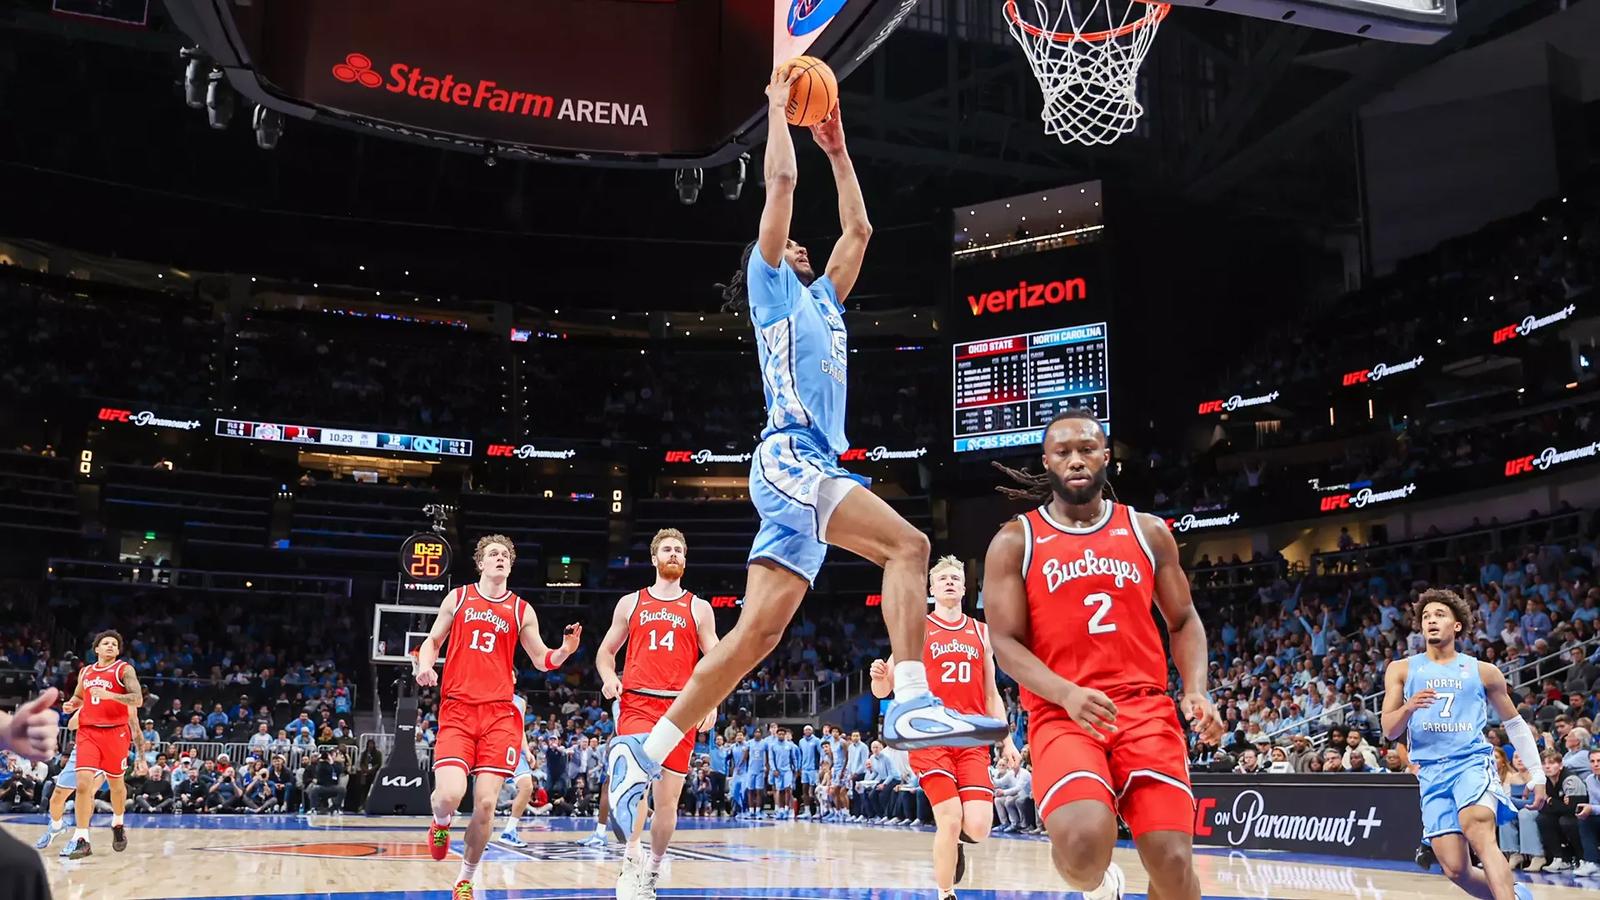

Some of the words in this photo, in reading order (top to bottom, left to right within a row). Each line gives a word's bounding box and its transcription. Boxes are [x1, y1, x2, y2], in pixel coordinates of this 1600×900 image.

[557, 98, 648, 127] ARENA
[968, 277, 1086, 316] verizon
[1033, 334, 1060, 346] NORTH
[1061, 327, 1102, 340] CAROLINA
[1493, 324, 1518, 344] UFC
[968, 344, 988, 354] OHIO
[990, 340, 1014, 352] STATE
[1343, 370, 1370, 386] UFC
[98, 408, 131, 422] UFC
[1199, 400, 1224, 414] UFC
[298, 427, 308, 438] 11
[330, 433, 353, 443] 10:23
[977, 436, 999, 448] CBS
[1000, 430, 1042, 446] SPORTS
[487, 445, 516, 456] UFC
[666, 451, 693, 462] UFC
[1505, 454, 1535, 476] UFC
[1320, 494, 1352, 511] UFC
[415, 543, 442, 556] 10:23
[411, 555, 439, 576] 26
[1042, 549, 1141, 593] Buckeyes
[712, 596, 737, 607] UFC
[866, 595, 882, 606] UF
[464, 607, 509, 634] Buckeyes
[640, 608, 686, 628] Buckeyes
[1083, 592, 1116, 634] 2
[469, 629, 496, 653] 13
[648, 630, 675, 651] 14
[930, 638, 979, 660] Buckeyes
[941, 661, 971, 683] 20
[1426, 679, 1462, 689] NORTH
[1434, 692, 1455, 718] 7
[1422, 722, 1473, 732] CAROLINA
[1193, 798, 1216, 836] C
[1215, 812, 1230, 826] ON
[1228, 790, 1382, 846] Paramount+
